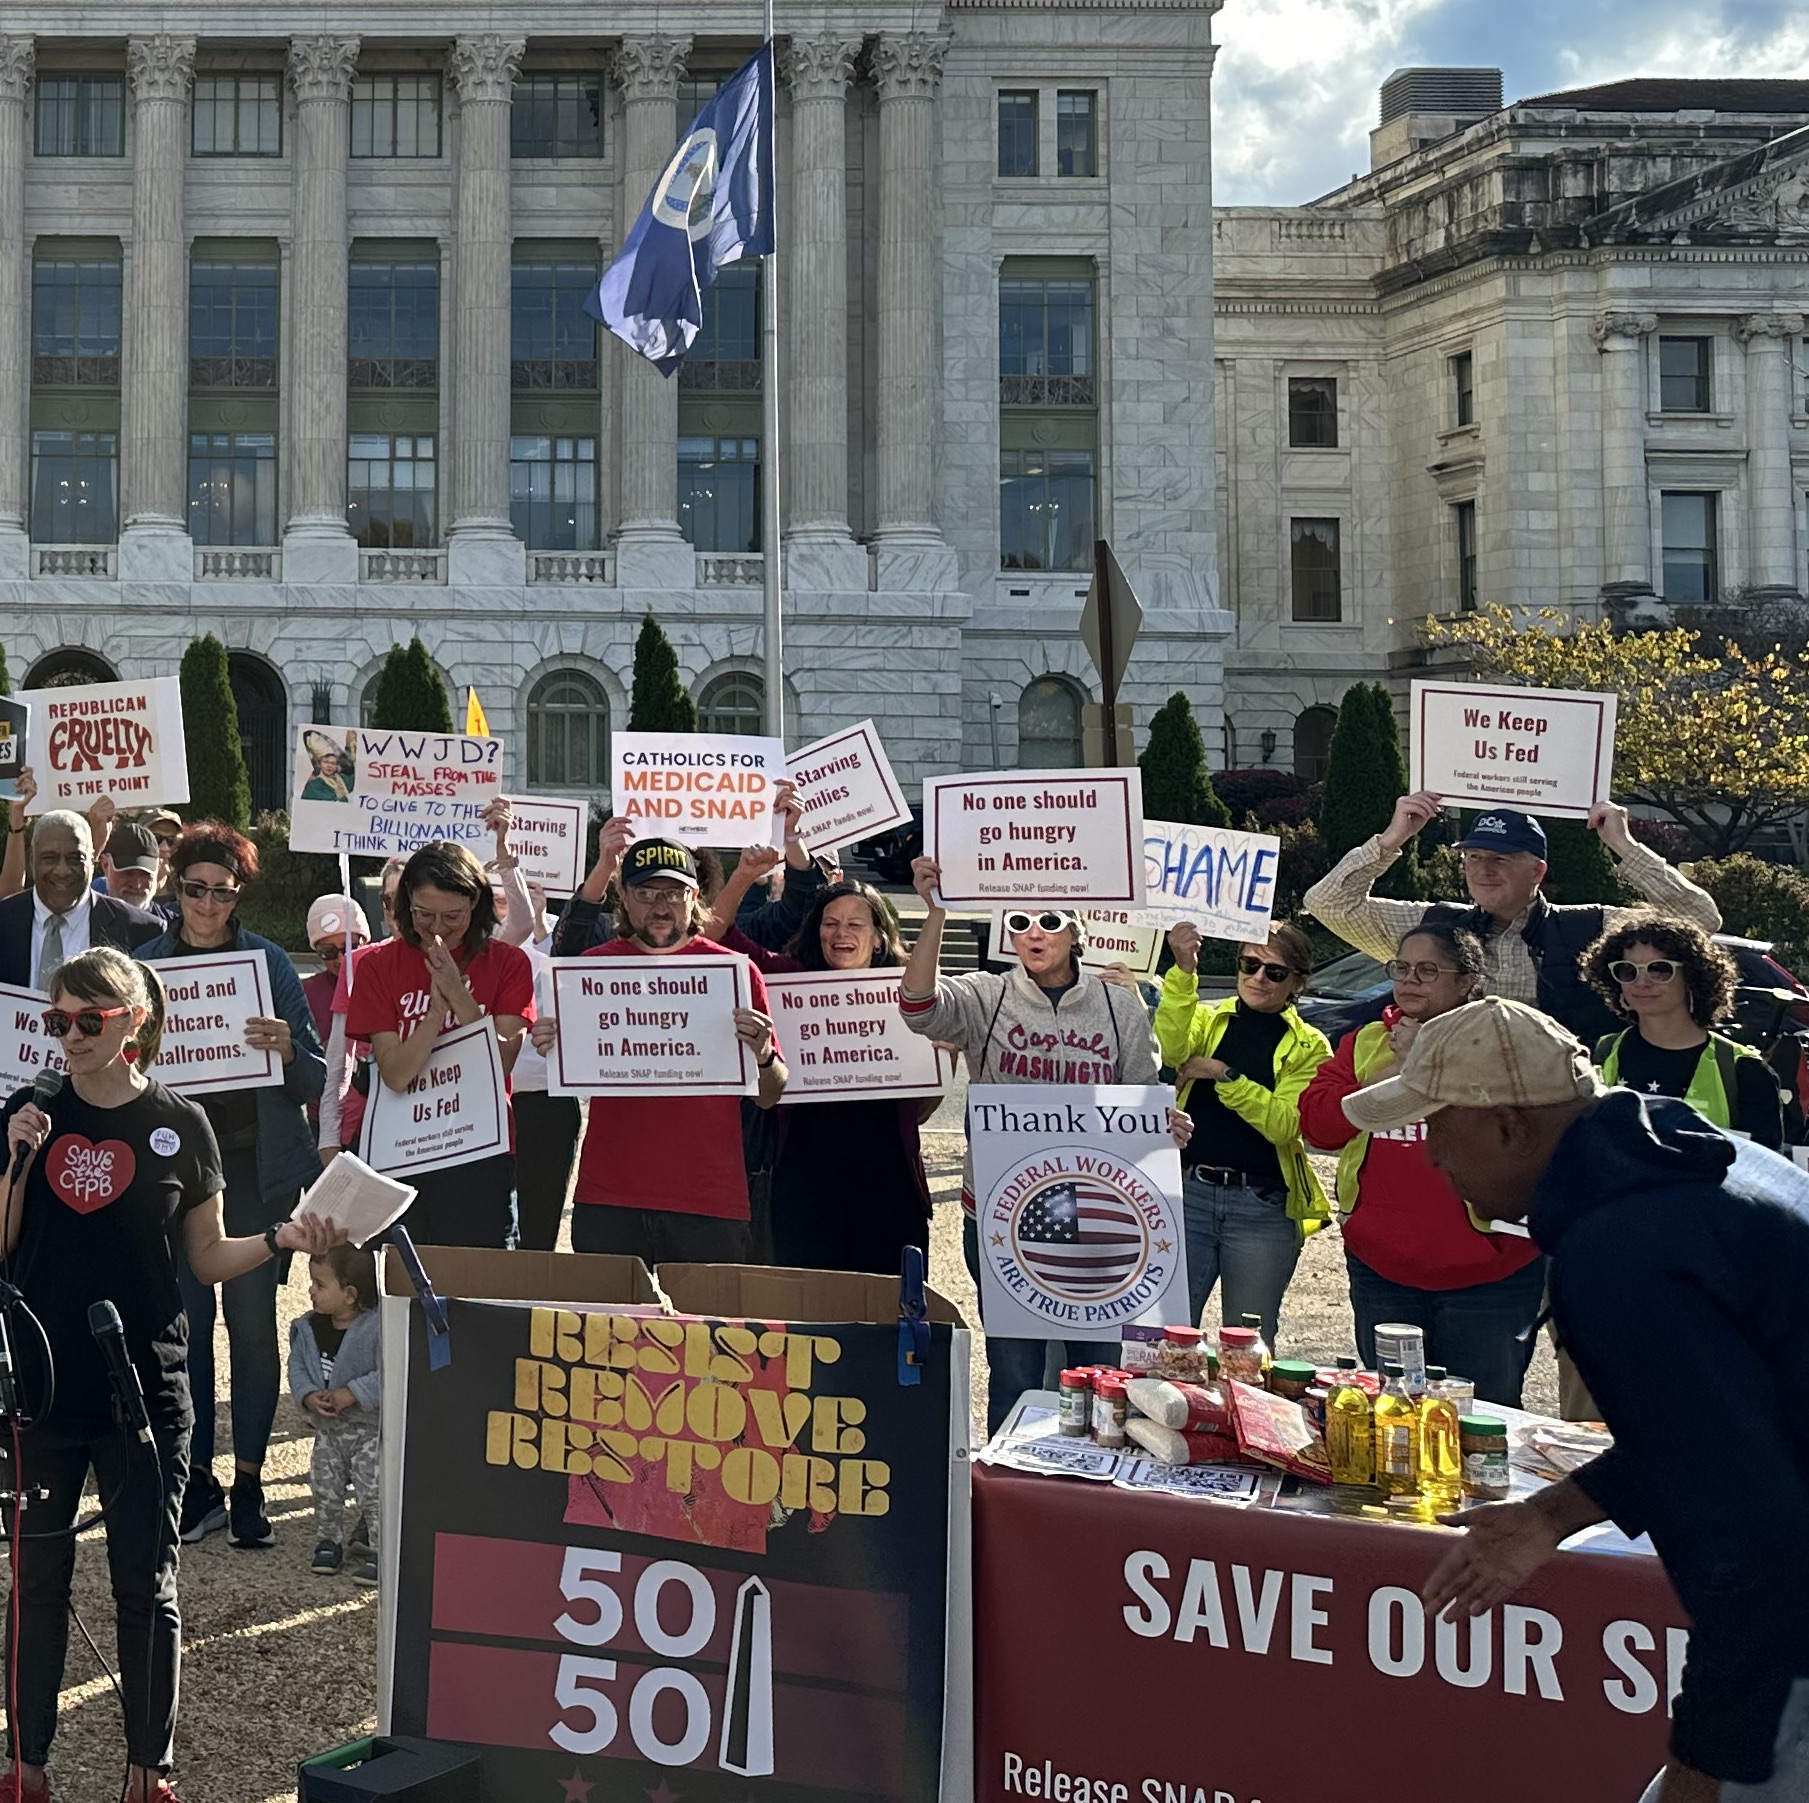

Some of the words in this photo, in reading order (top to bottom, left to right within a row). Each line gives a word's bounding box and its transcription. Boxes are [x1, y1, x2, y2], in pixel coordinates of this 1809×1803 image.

[49, 696, 146, 719] REPUBLICAN
[1464, 709, 1491, 729] We
[1498, 710, 1548, 736] Keep
[49, 717, 154, 773] CRUELTY
[1474, 740, 1499, 759] Us
[1504, 742, 1540, 764] Fed
[623, 752, 726, 767] CATHOLICS
[731, 754, 764, 768] FOR
[368, 762, 425, 781] STEAL
[434, 767, 467, 782] FROM
[471, 770, 497, 784] THE
[624, 771, 766, 793] MEDICAID
[58, 782, 72, 796] IS
[77, 780, 104, 795] THE
[108, 775, 150, 792] POINT
[392, 782, 456, 797] MASSES
[359, 796, 378, 809] TO
[382, 800, 417, 813] GIVE
[425, 802, 446, 816] TO
[451, 804, 485, 820] THE
[625, 799, 682, 817] AND
[691, 799, 766, 819] SNAP
[964, 793, 985, 811] No
[993, 797, 1027, 810] one
[1033, 790, 1097, 809] should
[333, 831, 341, 847] I
[343, 833, 387, 850] THINK
[980, 828, 1001, 844] go
[1009, 822, 1076, 844] hungry
[635, 845, 687, 868] SPIRIT
[977, 854, 995, 871] in
[1003, 851, 1088, 871] America.
[979, 883, 1010, 893] Release
[1013, 883, 1035, 893] SNAP
[1038, 883, 1068, 894] funding
[1071, 883, 1090, 893] now!
[582, 977, 604, 995] No
[610, 979, 641, 995] one
[648, 975, 708, 995] should
[782, 991, 804, 1010] No
[810, 992, 840, 1008] one
[599, 1011, 620, 1030] go
[626, 1008, 688, 1029] hungry
[800, 1023, 820, 1040] go
[826, 1020, 886, 1038] hungry
[598, 1037, 613, 1056] in
[621, 1037, 701, 1056] America.
[1008, 1024, 1110, 1061] Capitals
[800, 1049, 816, 1066] in
[822, 1045, 899, 1065] America.
[430, 1064, 461, 1089] Keep
[413, 1102, 432, 1123] Us
[436, 1095, 460, 1117] Fed
[974, 1104, 1087, 1133] Thank
[1096, 1106, 1173, 1134] You!
[65, 1145, 114, 1171] SAVE
[72, 1164, 104, 1178] the
[60, 1170, 112, 1202] CFPB
[993, 1156, 1069, 1223] FEDERAL
[1076, 1156, 1166, 1231] WORKERS
[997, 1255, 1029, 1293] ARE
[1027, 1288, 1079, 1321] TRUE
[1086, 1263, 1164, 1322] PATRIOTS
[530, 1306, 841, 1390] RESIST
[515, 1357, 867, 1454] REMOVE
[486, 1410, 891, 1516] RESTORE
[553, 1546, 716, 1658] 50
[1123, 1550, 1333, 1665] SAVE
[1368, 1586, 1566, 1701] OUR
[548, 1653, 712, 1766] 50
